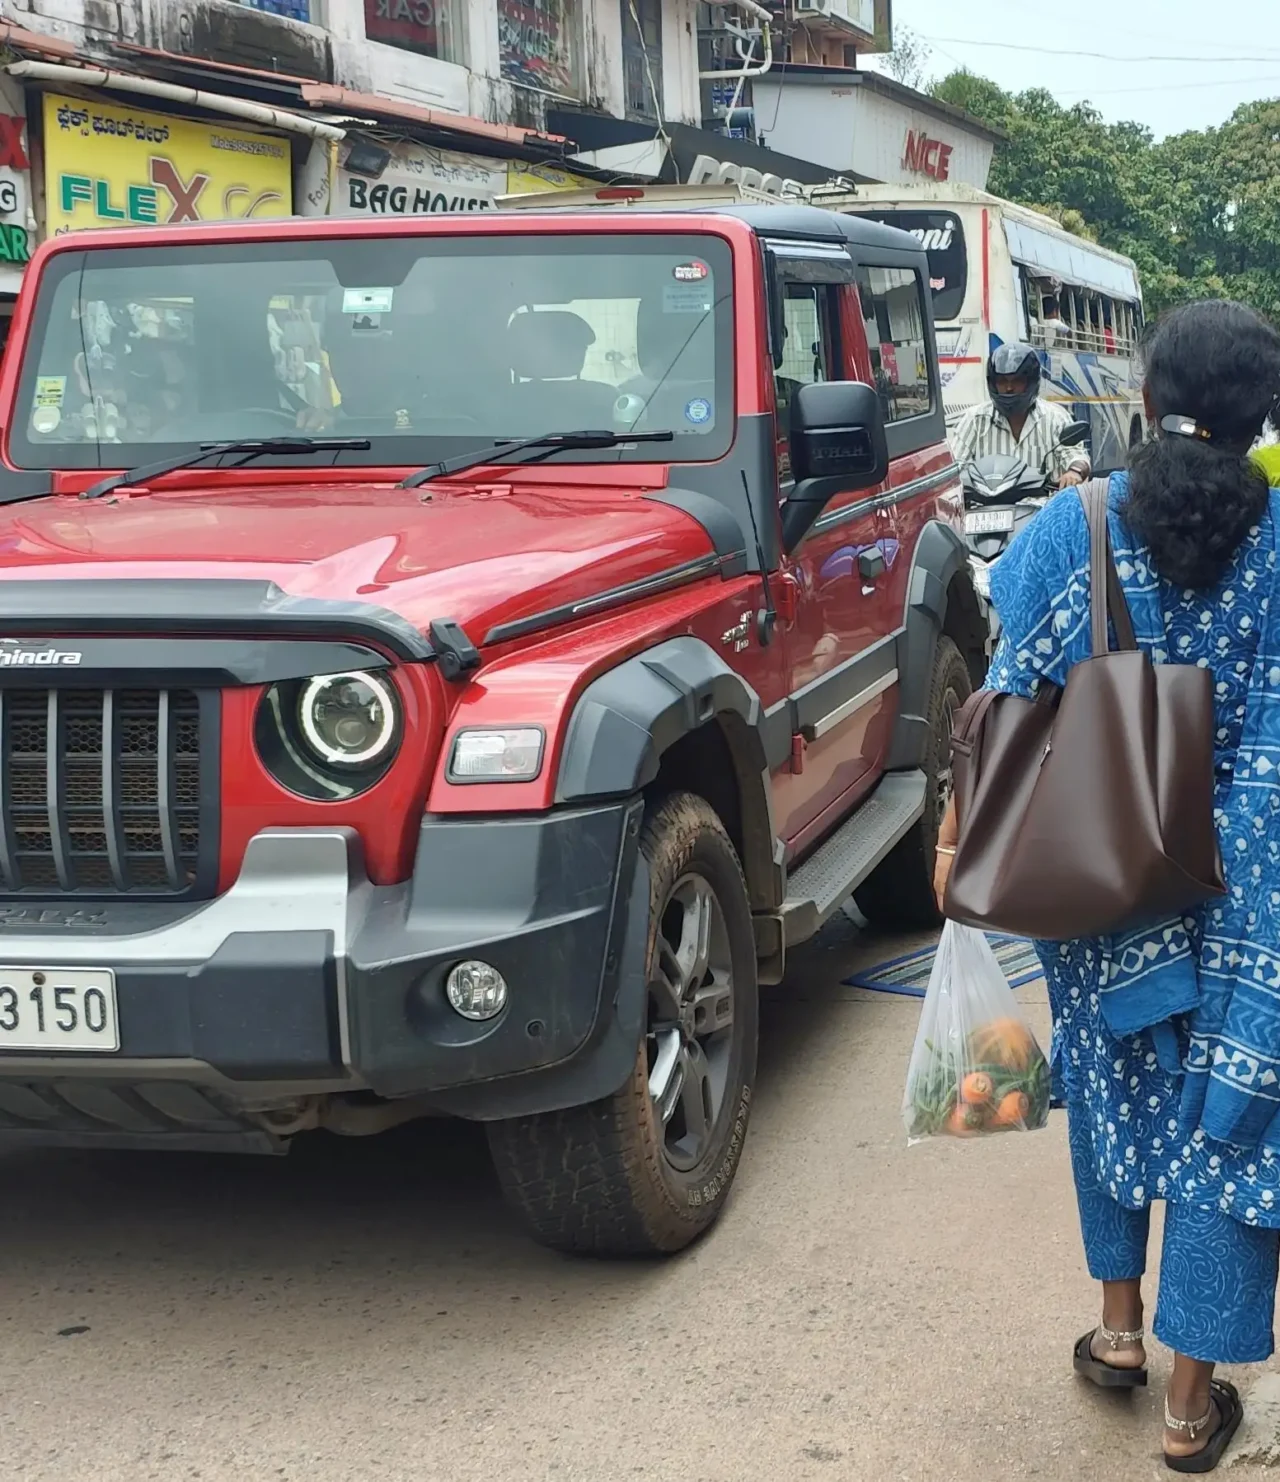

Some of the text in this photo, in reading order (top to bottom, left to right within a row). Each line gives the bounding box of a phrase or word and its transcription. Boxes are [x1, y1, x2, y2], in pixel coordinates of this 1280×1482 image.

[61, 156, 211, 225] FLEX
[349, 178, 407, 214] BAG
[0, 986, 107, 1032] 3150
